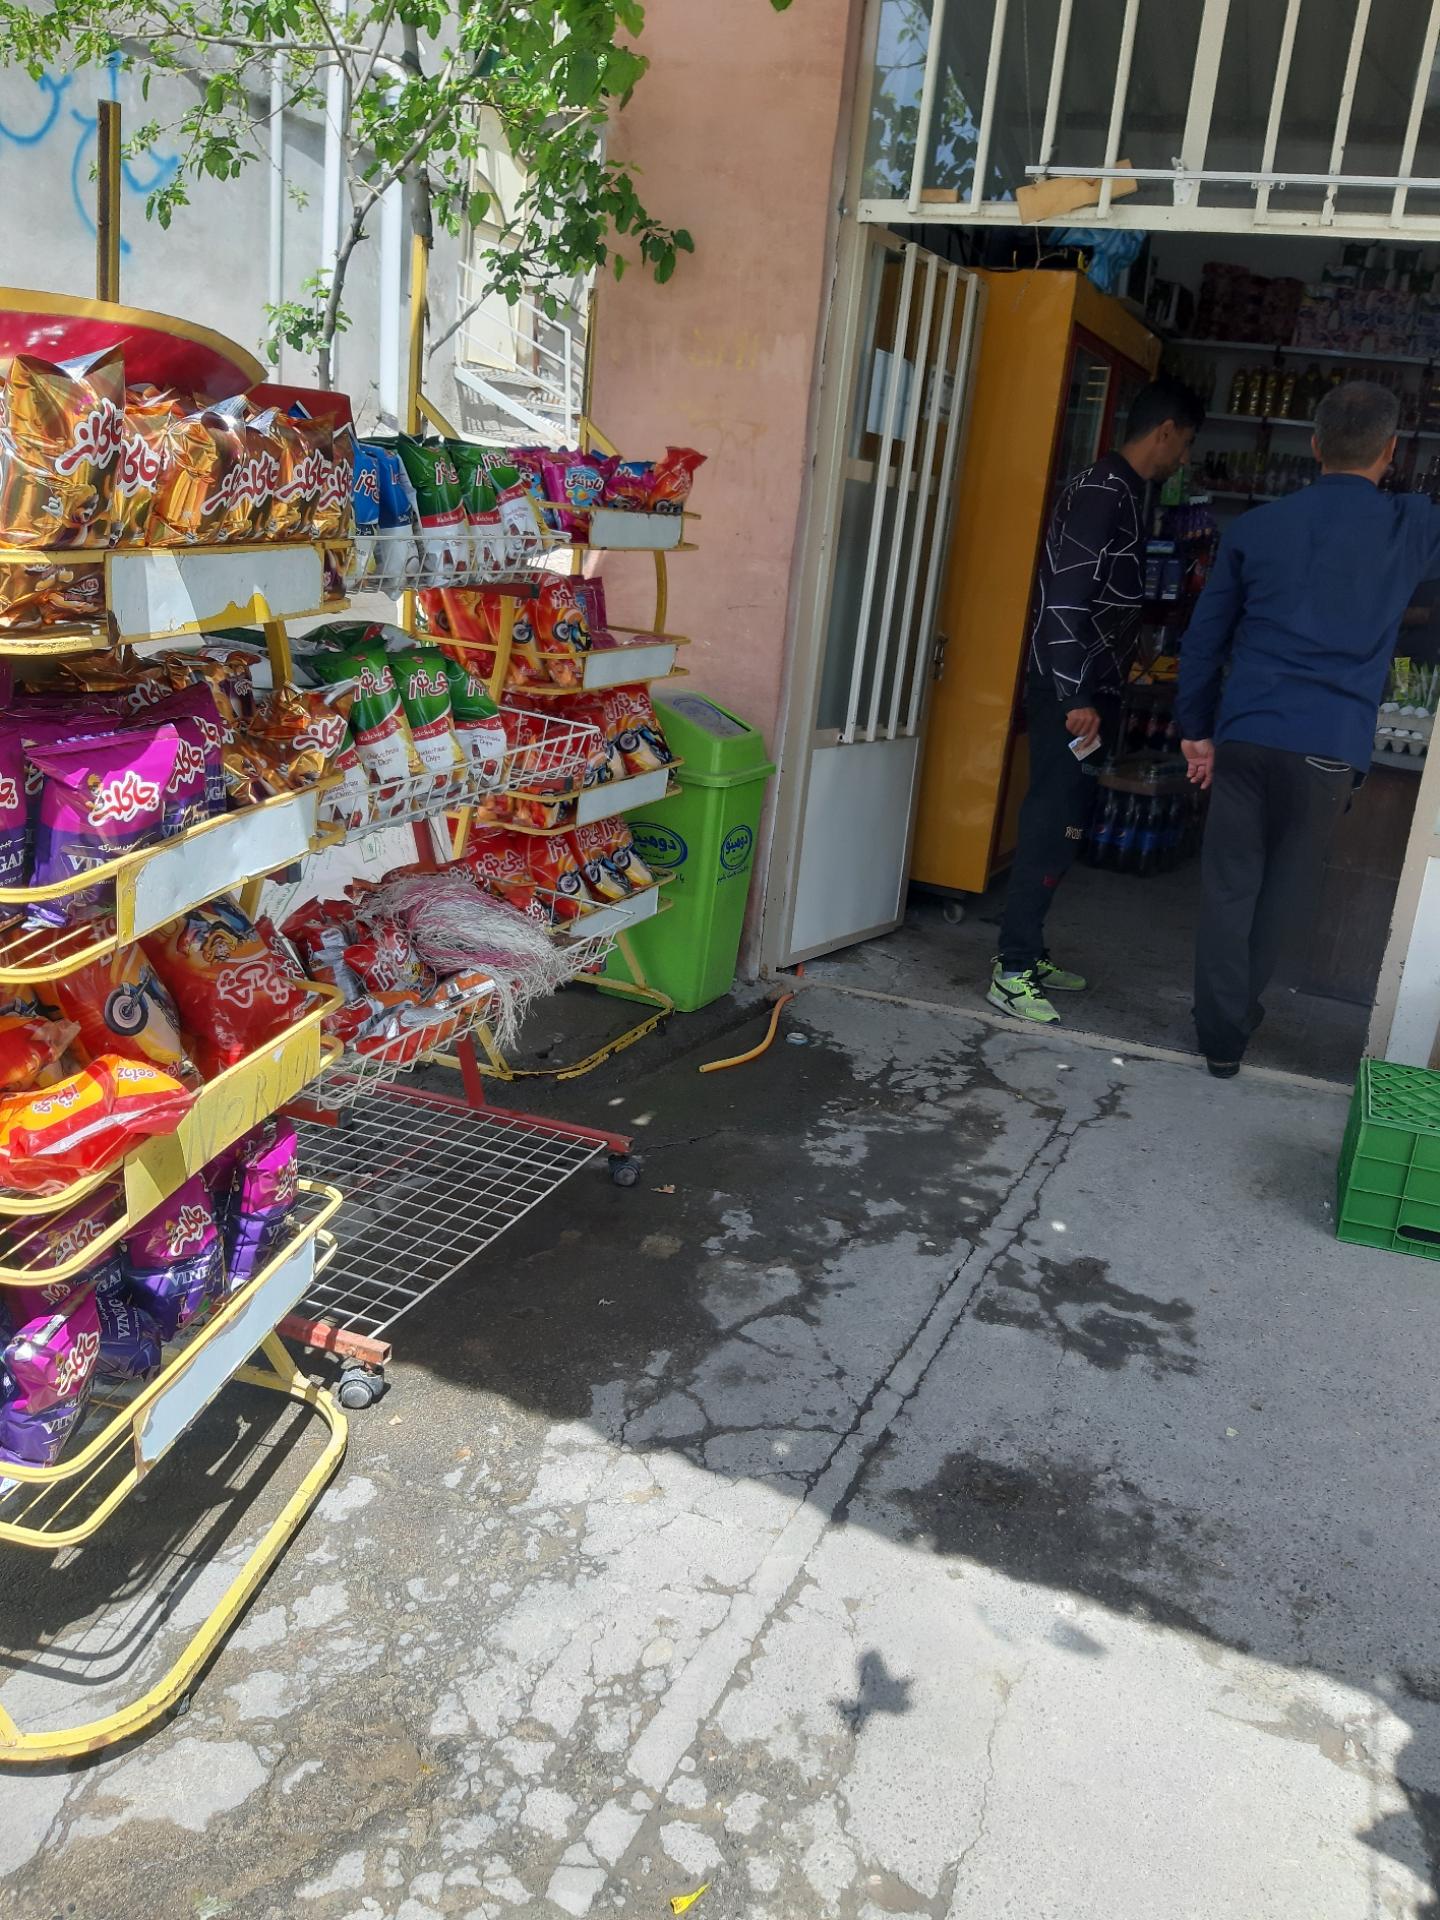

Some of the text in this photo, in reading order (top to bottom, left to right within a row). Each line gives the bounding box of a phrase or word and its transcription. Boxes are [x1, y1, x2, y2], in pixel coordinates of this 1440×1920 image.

[293, 714, 348, 758] اکلز
[412, 730, 436, 743] etchup
[88, 771, 160, 827] چاکلز
